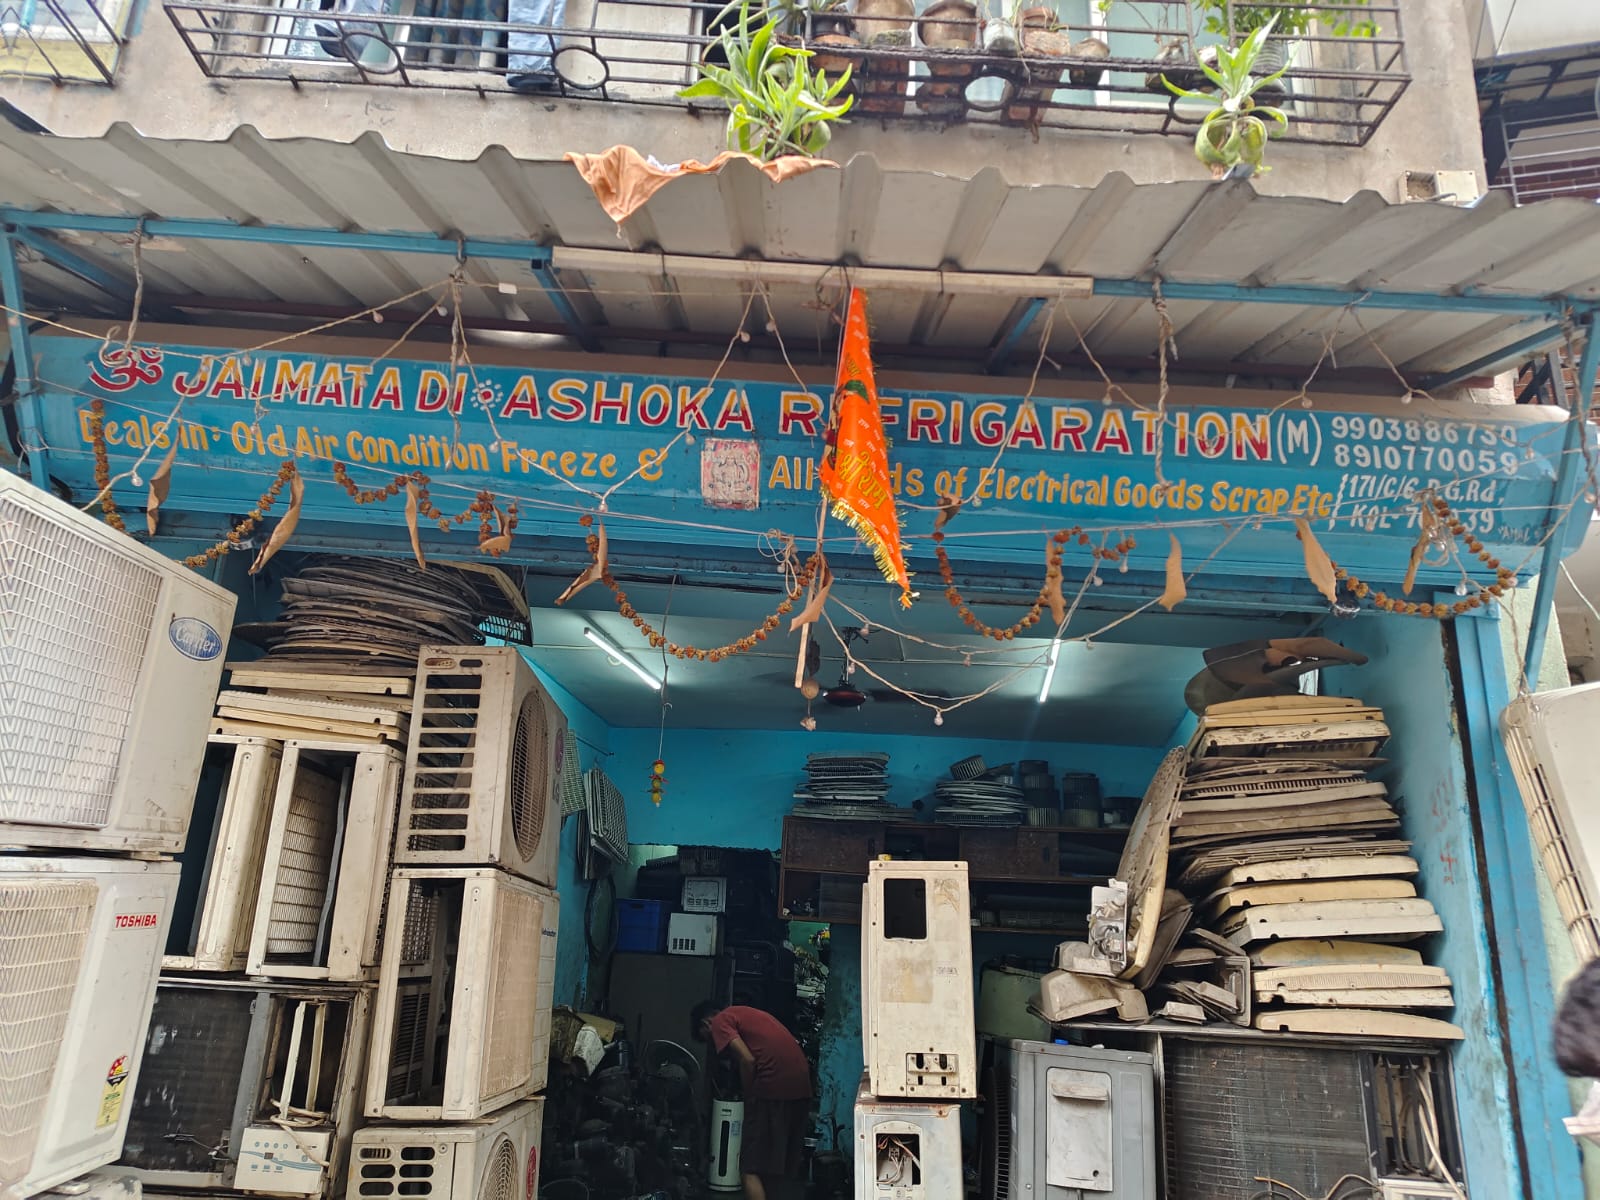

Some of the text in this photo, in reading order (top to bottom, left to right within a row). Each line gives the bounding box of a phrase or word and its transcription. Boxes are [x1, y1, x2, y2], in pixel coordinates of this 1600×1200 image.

[415, 368, 468, 415] DI
[500, 374, 755, 433] ASHOKA
[778, 390, 1272, 461] RFRIGARATION
[1277, 412, 1322, 466] (M)
[1331, 415, 1518, 448] 9903886730
[79, 409, 171, 450] Deals
[231, 420, 289, 457] Old
[294, 425, 339, 460] Air
[346, 430, 490, 472] Condition
[638, 447, 669, 482] &
[1334, 444, 1520, 475] 8910770059
[768, 454, 814, 491] All
[978, 467, 1109, 507] Electrical
[1113, 475, 1204, 511] Goods
[1210, 480, 1290, 517] Scrap
[1291, 484, 1333, 517] Etc
[115, 914, 157, 928] TOSHIBA
